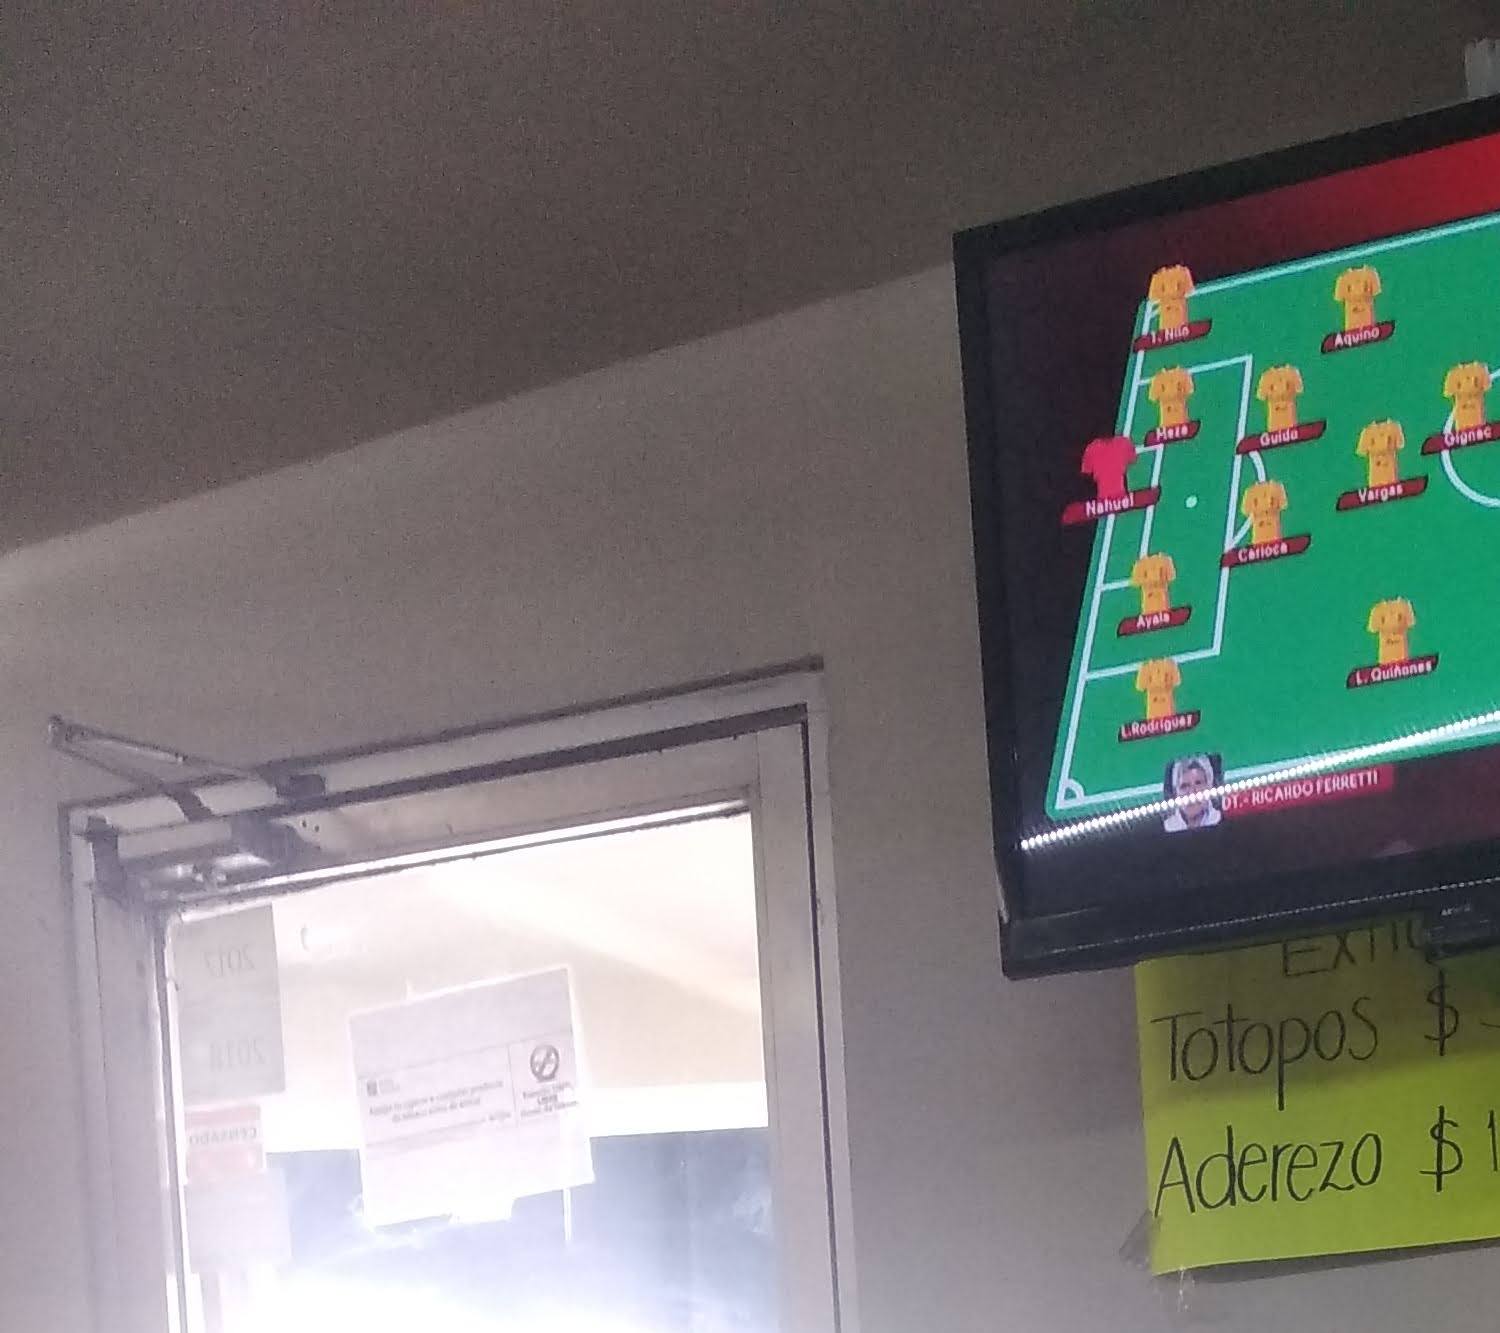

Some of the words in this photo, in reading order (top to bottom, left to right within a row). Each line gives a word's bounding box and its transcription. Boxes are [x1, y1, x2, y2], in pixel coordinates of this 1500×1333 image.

[1334, 326, 1380, 348] Aquino
[1259, 428, 1299, 447] Guido
[1443, 426, 1493, 447] Gignac
[1085, 492, 1135, 518] Nahuel
[1358, 486, 1403, 504] Vargas
[1237, 541, 1288, 564] Carioca
[1136, 613, 1171, 630] Ayala
[1371, 660, 1433, 684] Quiñones
[1252, 783, 1313, 809] RICARDO
[1316, 770, 1379, 796] FERRETTI
[1151, 996, 1379, 1111] Totopos
[1153, 1125, 1383, 1218] Aderezo
